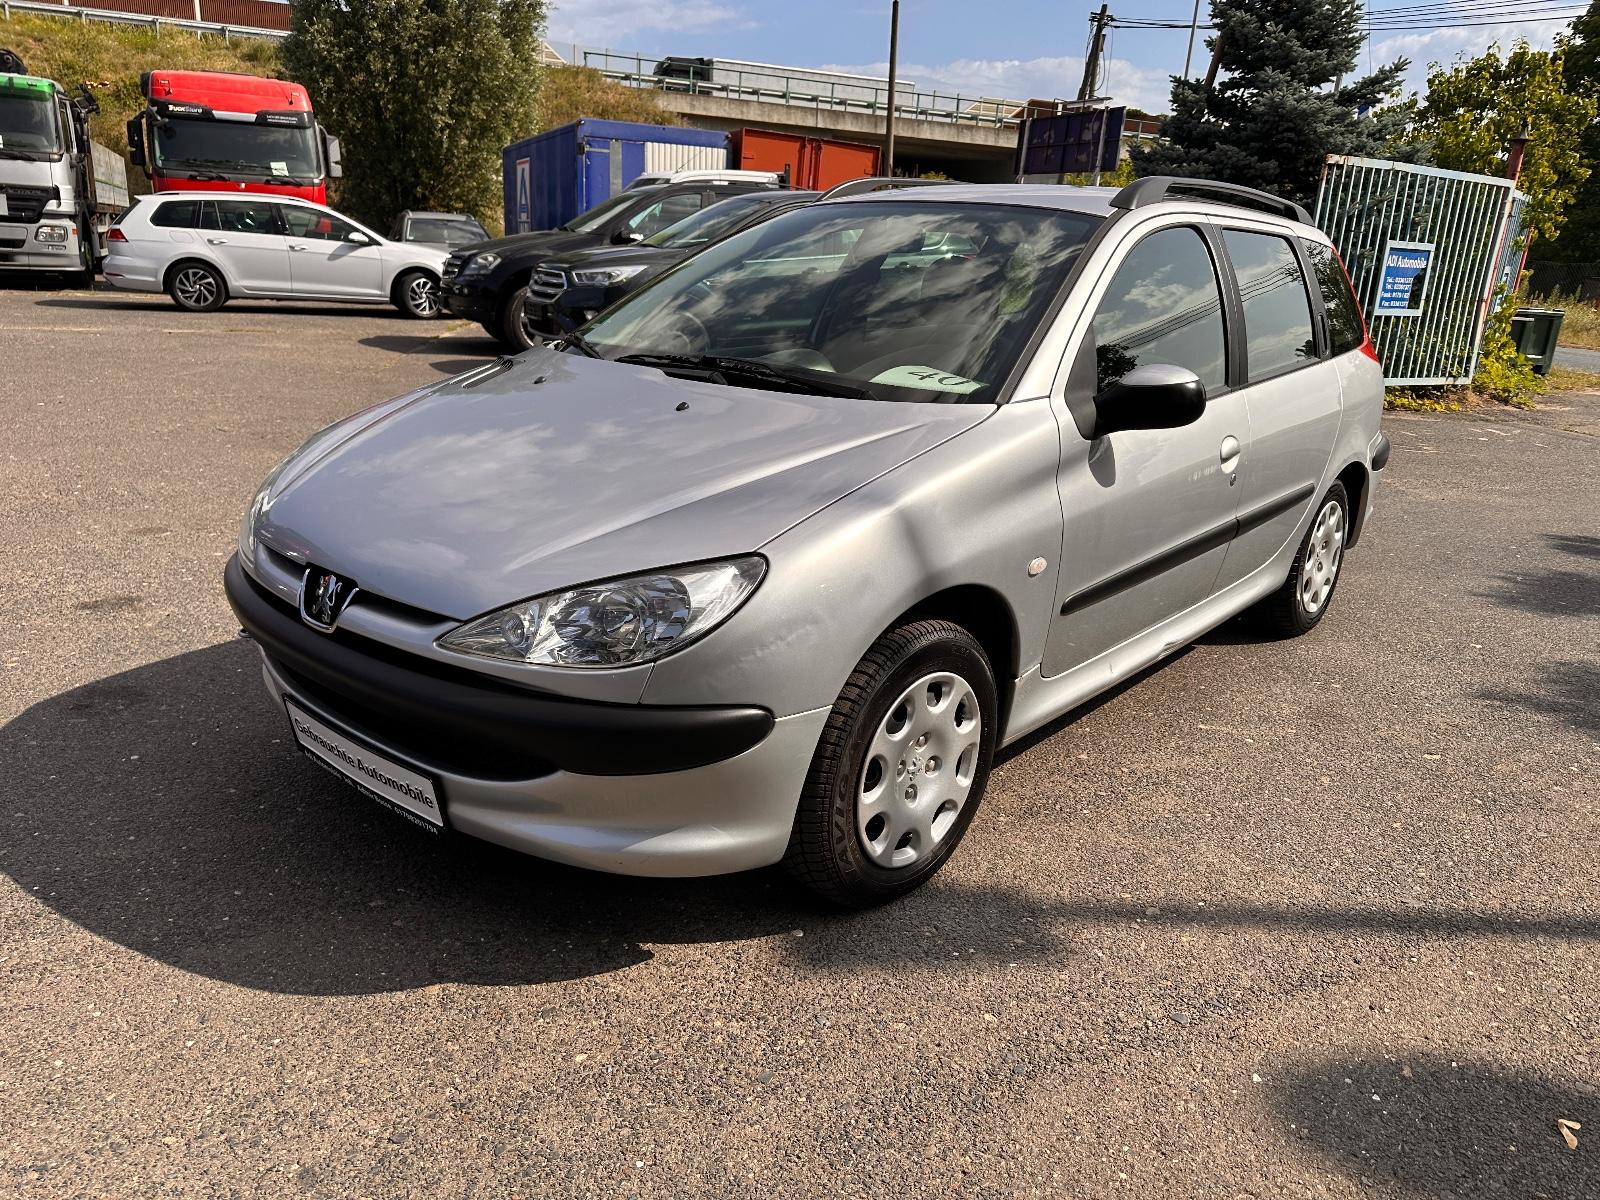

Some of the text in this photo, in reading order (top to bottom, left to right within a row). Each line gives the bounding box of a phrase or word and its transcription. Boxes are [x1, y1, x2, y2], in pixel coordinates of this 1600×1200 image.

[1397, 256, 1427, 268] Automobile
[294, 716, 355, 768] Gebrauchte
[357, 757, 434, 809] Automobile
